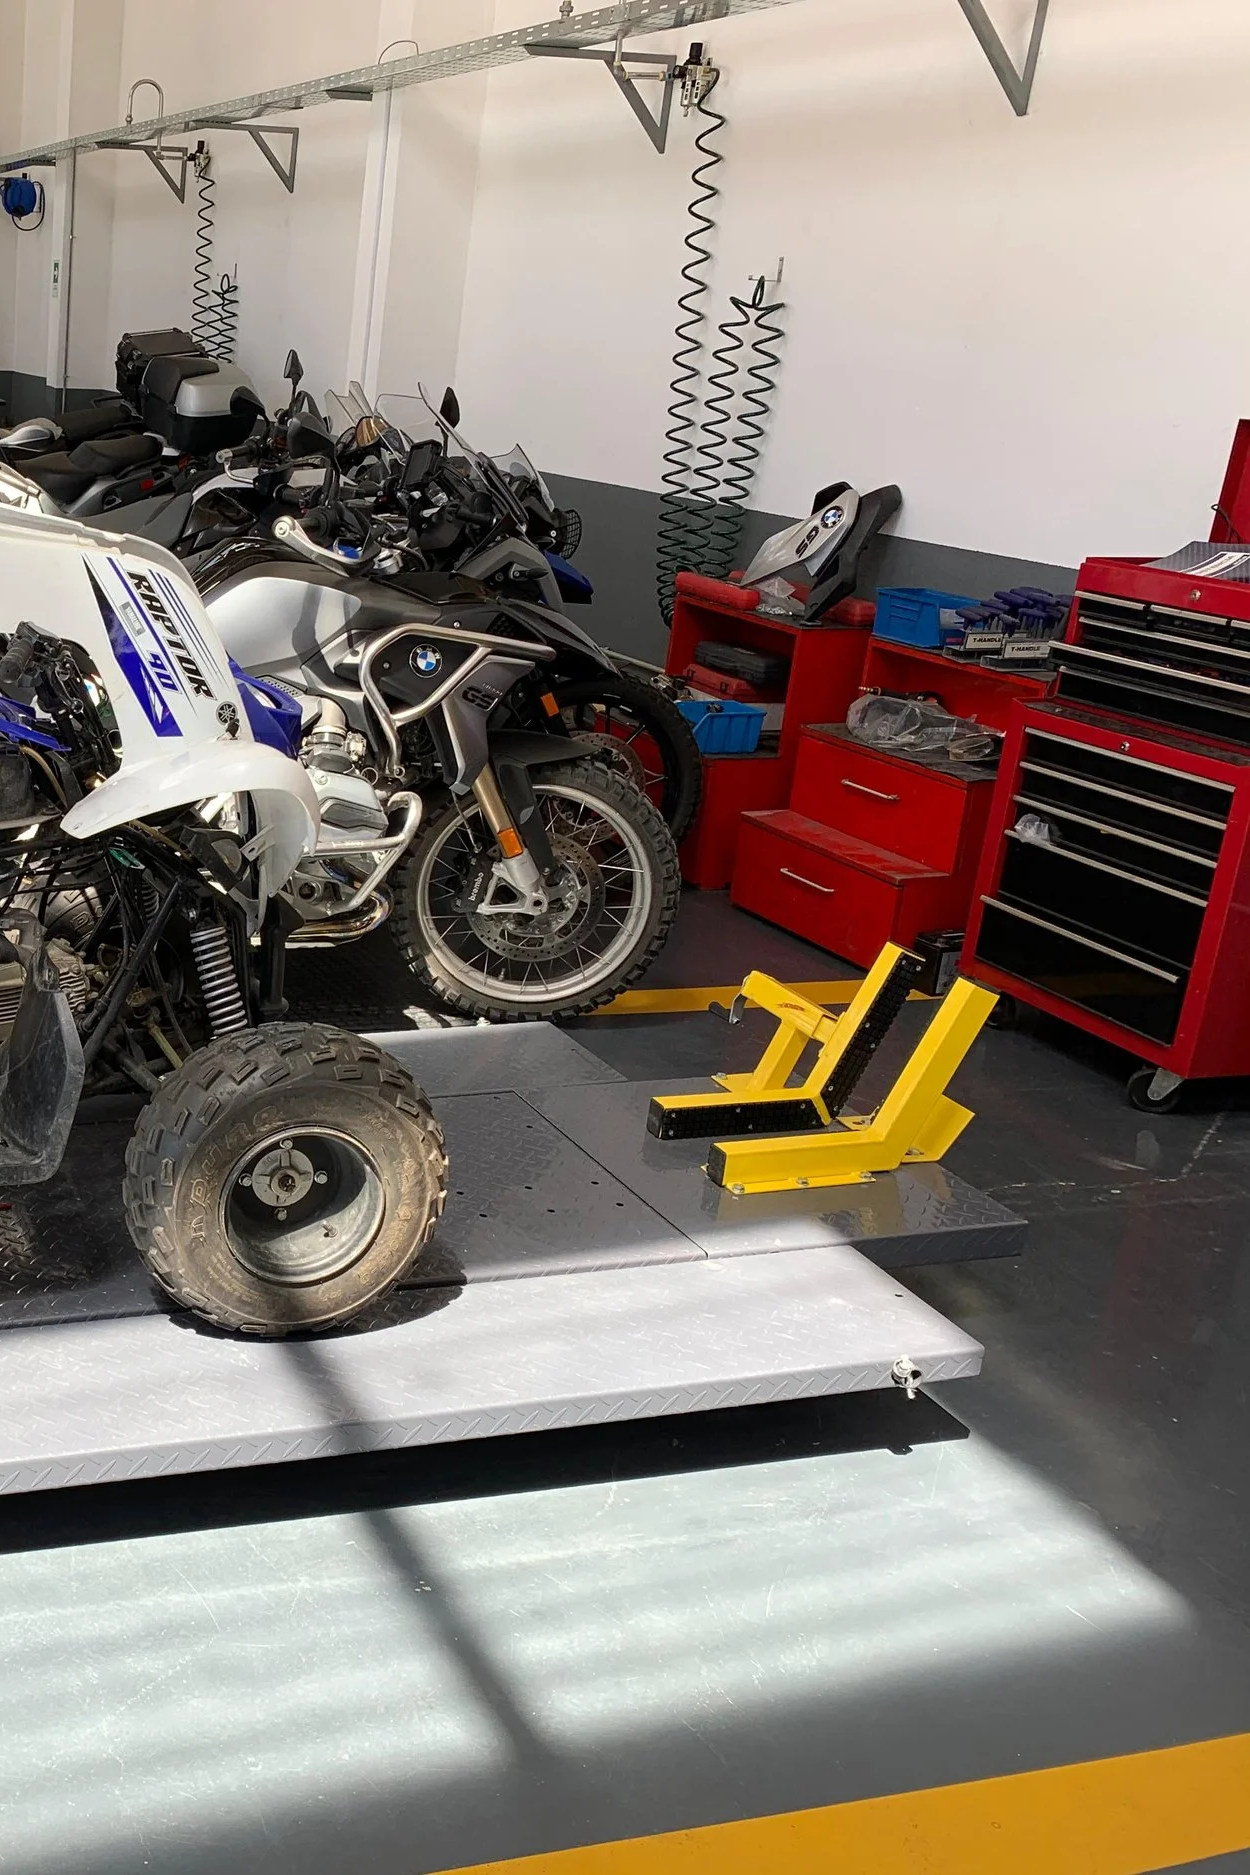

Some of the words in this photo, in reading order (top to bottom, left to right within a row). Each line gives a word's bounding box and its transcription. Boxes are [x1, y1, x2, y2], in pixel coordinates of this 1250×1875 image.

[126, 570, 215, 700] RAPTOR
[147, 652, 180, 694] 90
[468, 872, 484, 901] brembo
